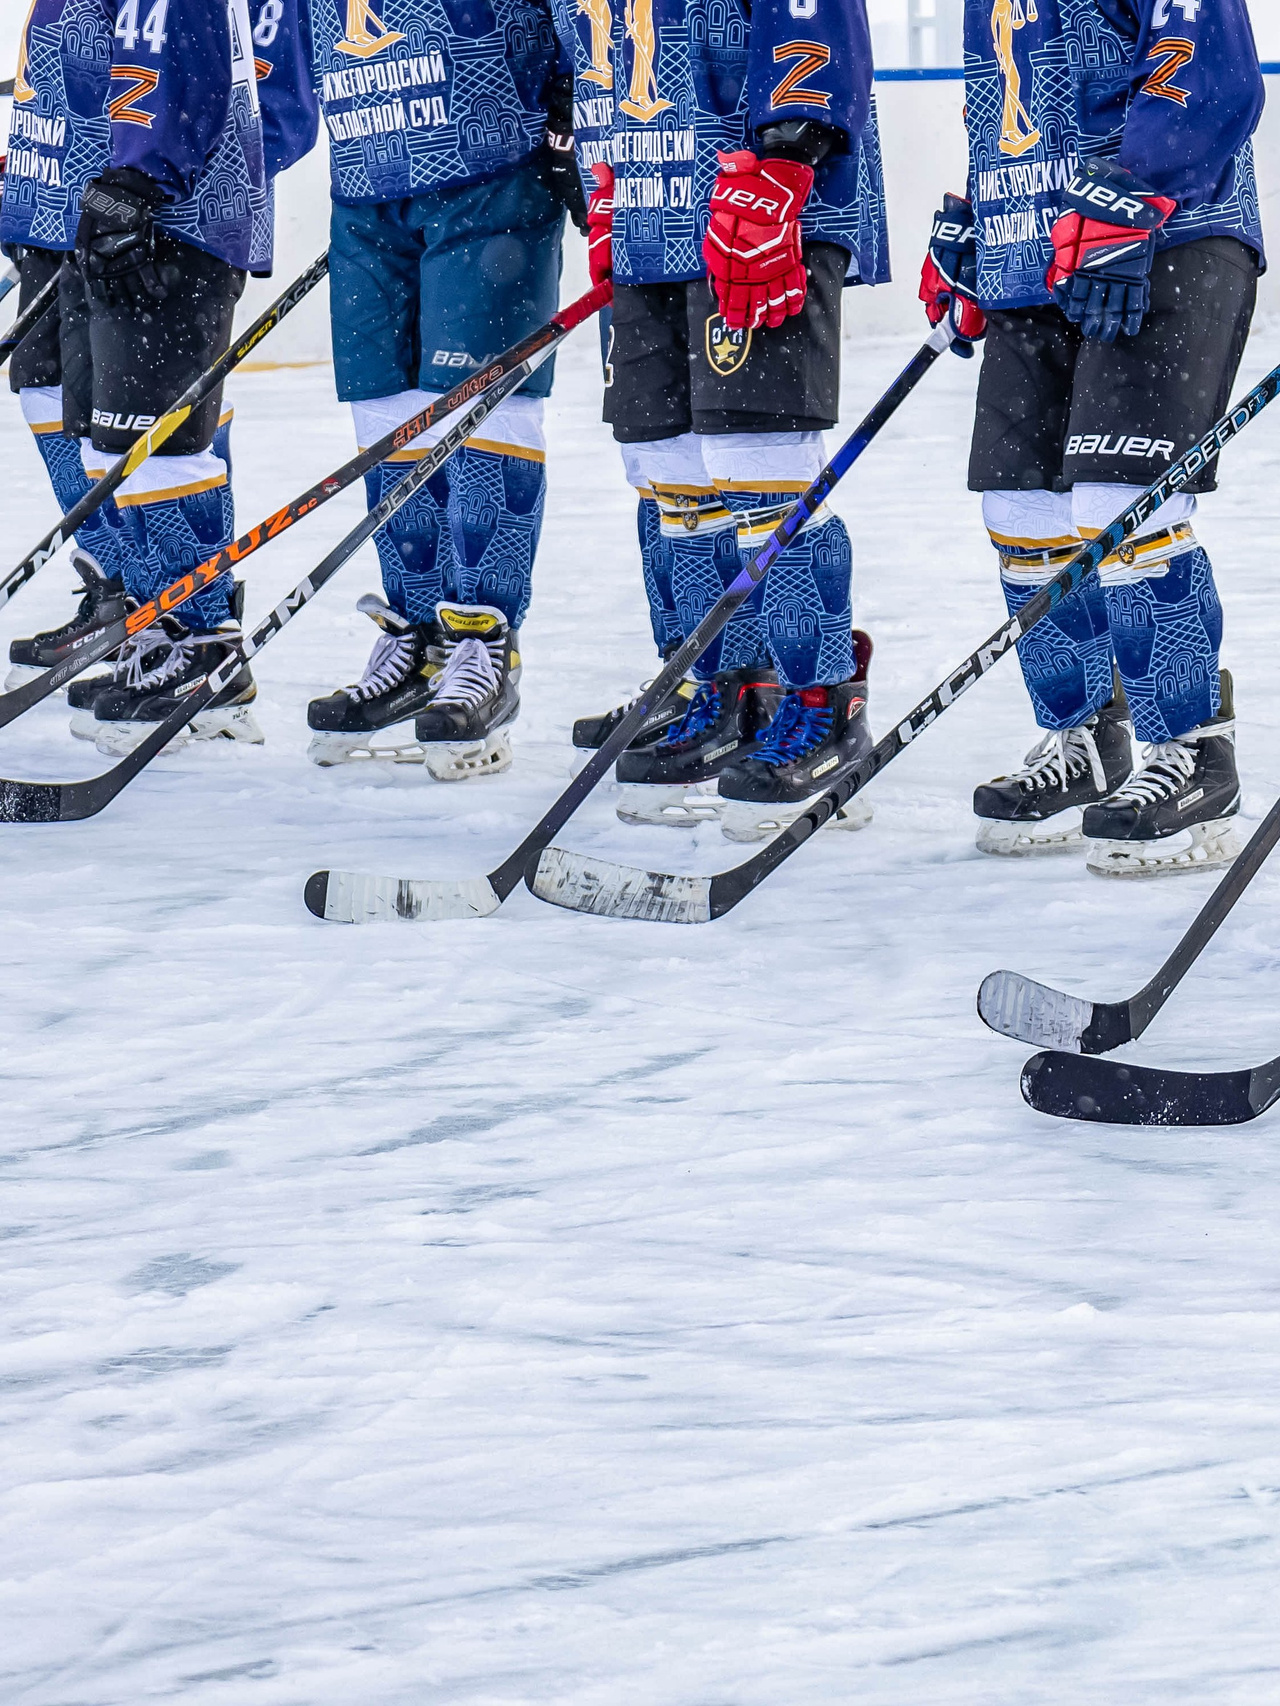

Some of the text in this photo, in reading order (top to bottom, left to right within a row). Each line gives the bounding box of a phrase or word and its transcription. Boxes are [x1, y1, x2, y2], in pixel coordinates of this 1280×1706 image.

[115, 0, 168, 53] 44
[323, 50, 447, 101] ИЖЕГОРОДСКИЙ
[770, 40, 832, 110] Z
[409, 96, 449, 128] СУД
[91, 407, 156, 431] BAUE
[1064, 434, 1175, 461] BAUER
[376, 401, 489, 522] JETSPEED
[1123, 406, 1250, 530] JETSPEED
[126, 505, 294, 635] SOYUZ
[207, 576, 316, 693] CCM
